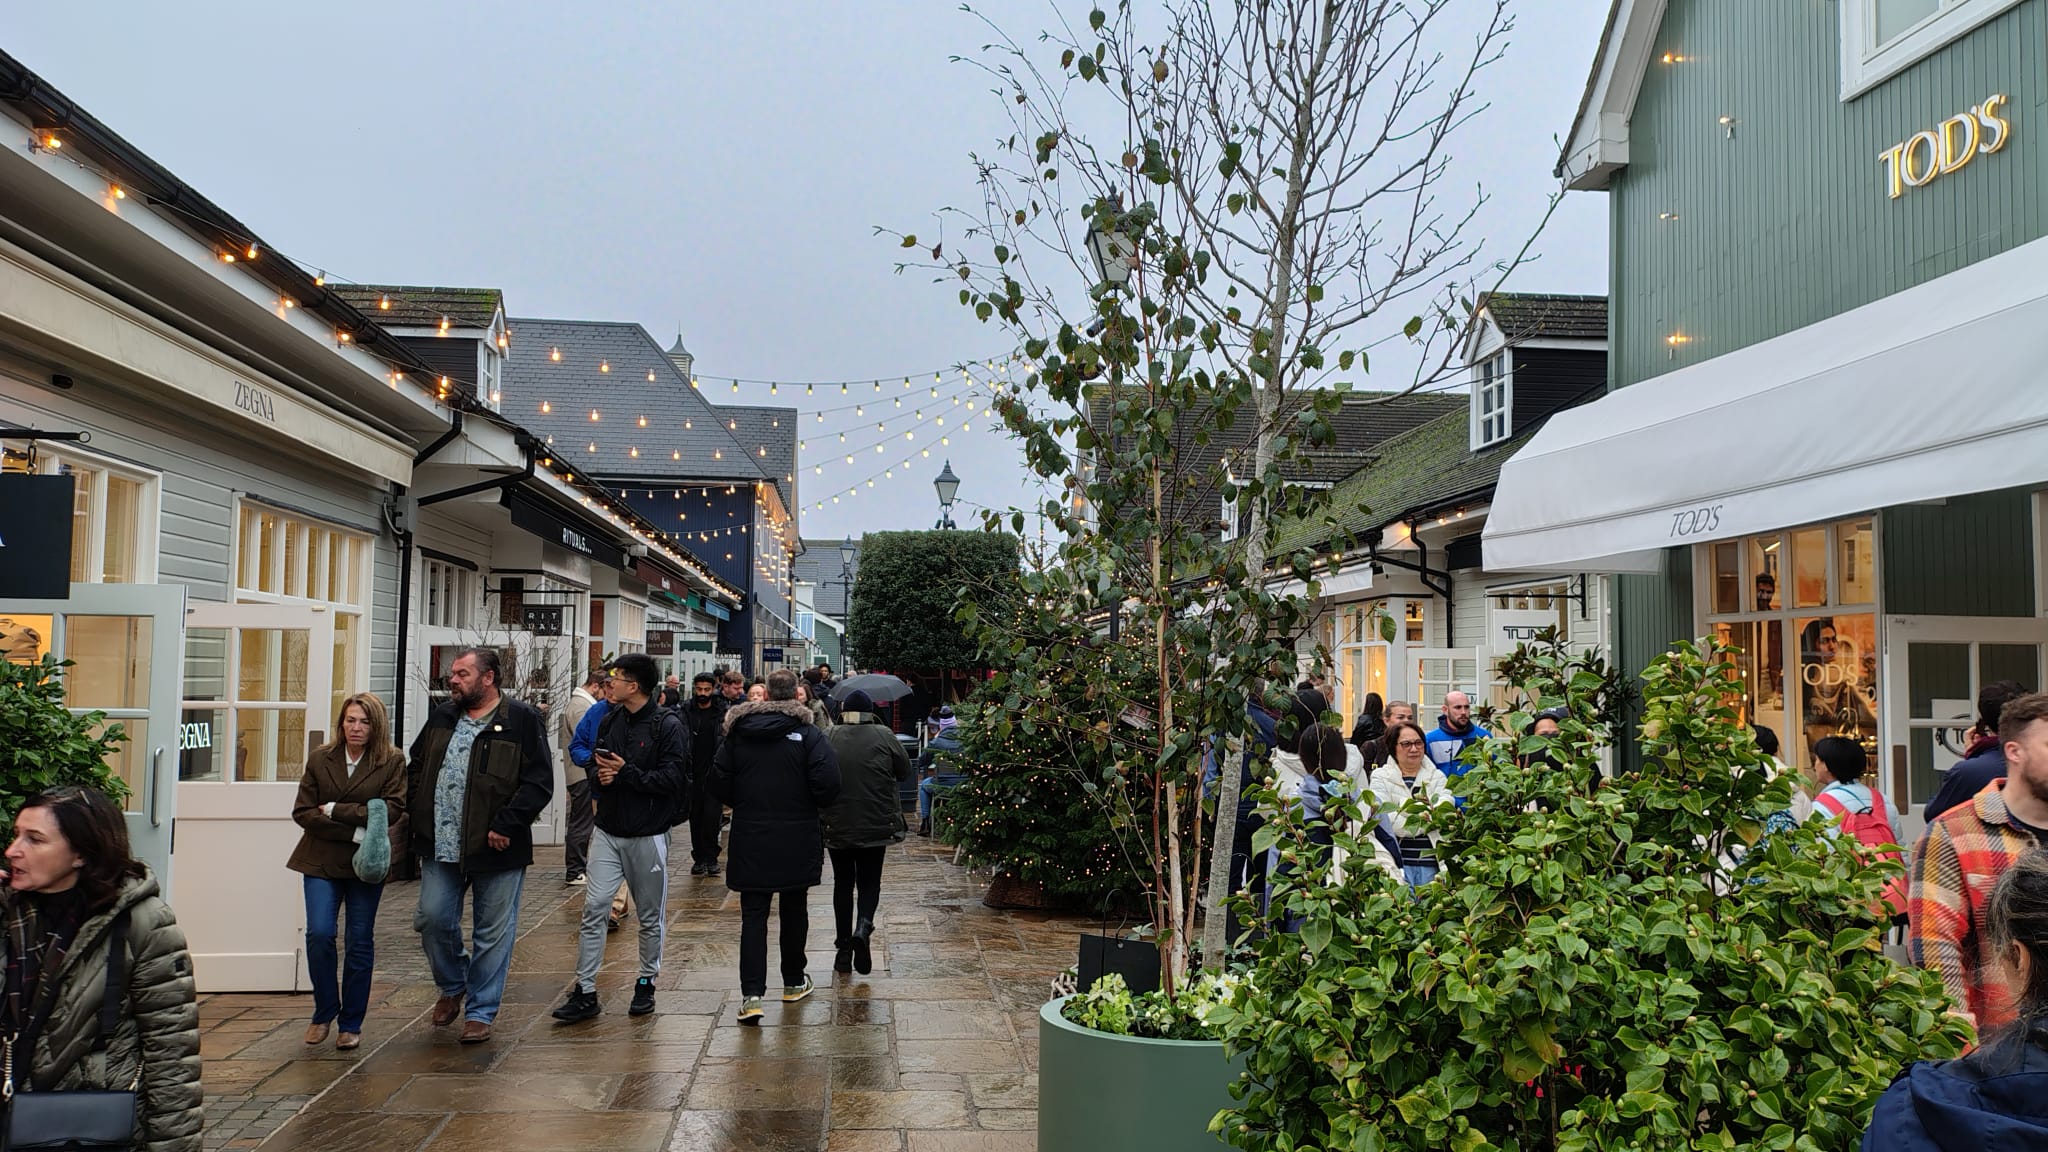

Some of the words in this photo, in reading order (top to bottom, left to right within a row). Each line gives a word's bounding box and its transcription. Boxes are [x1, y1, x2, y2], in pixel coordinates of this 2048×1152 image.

[1877, 93, 2008, 199] TOD'S
[234, 380, 275, 422] ZEGNA
[1669, 504, 1723, 538] TOD'S
[1800, 663, 1859, 686] OD'S
